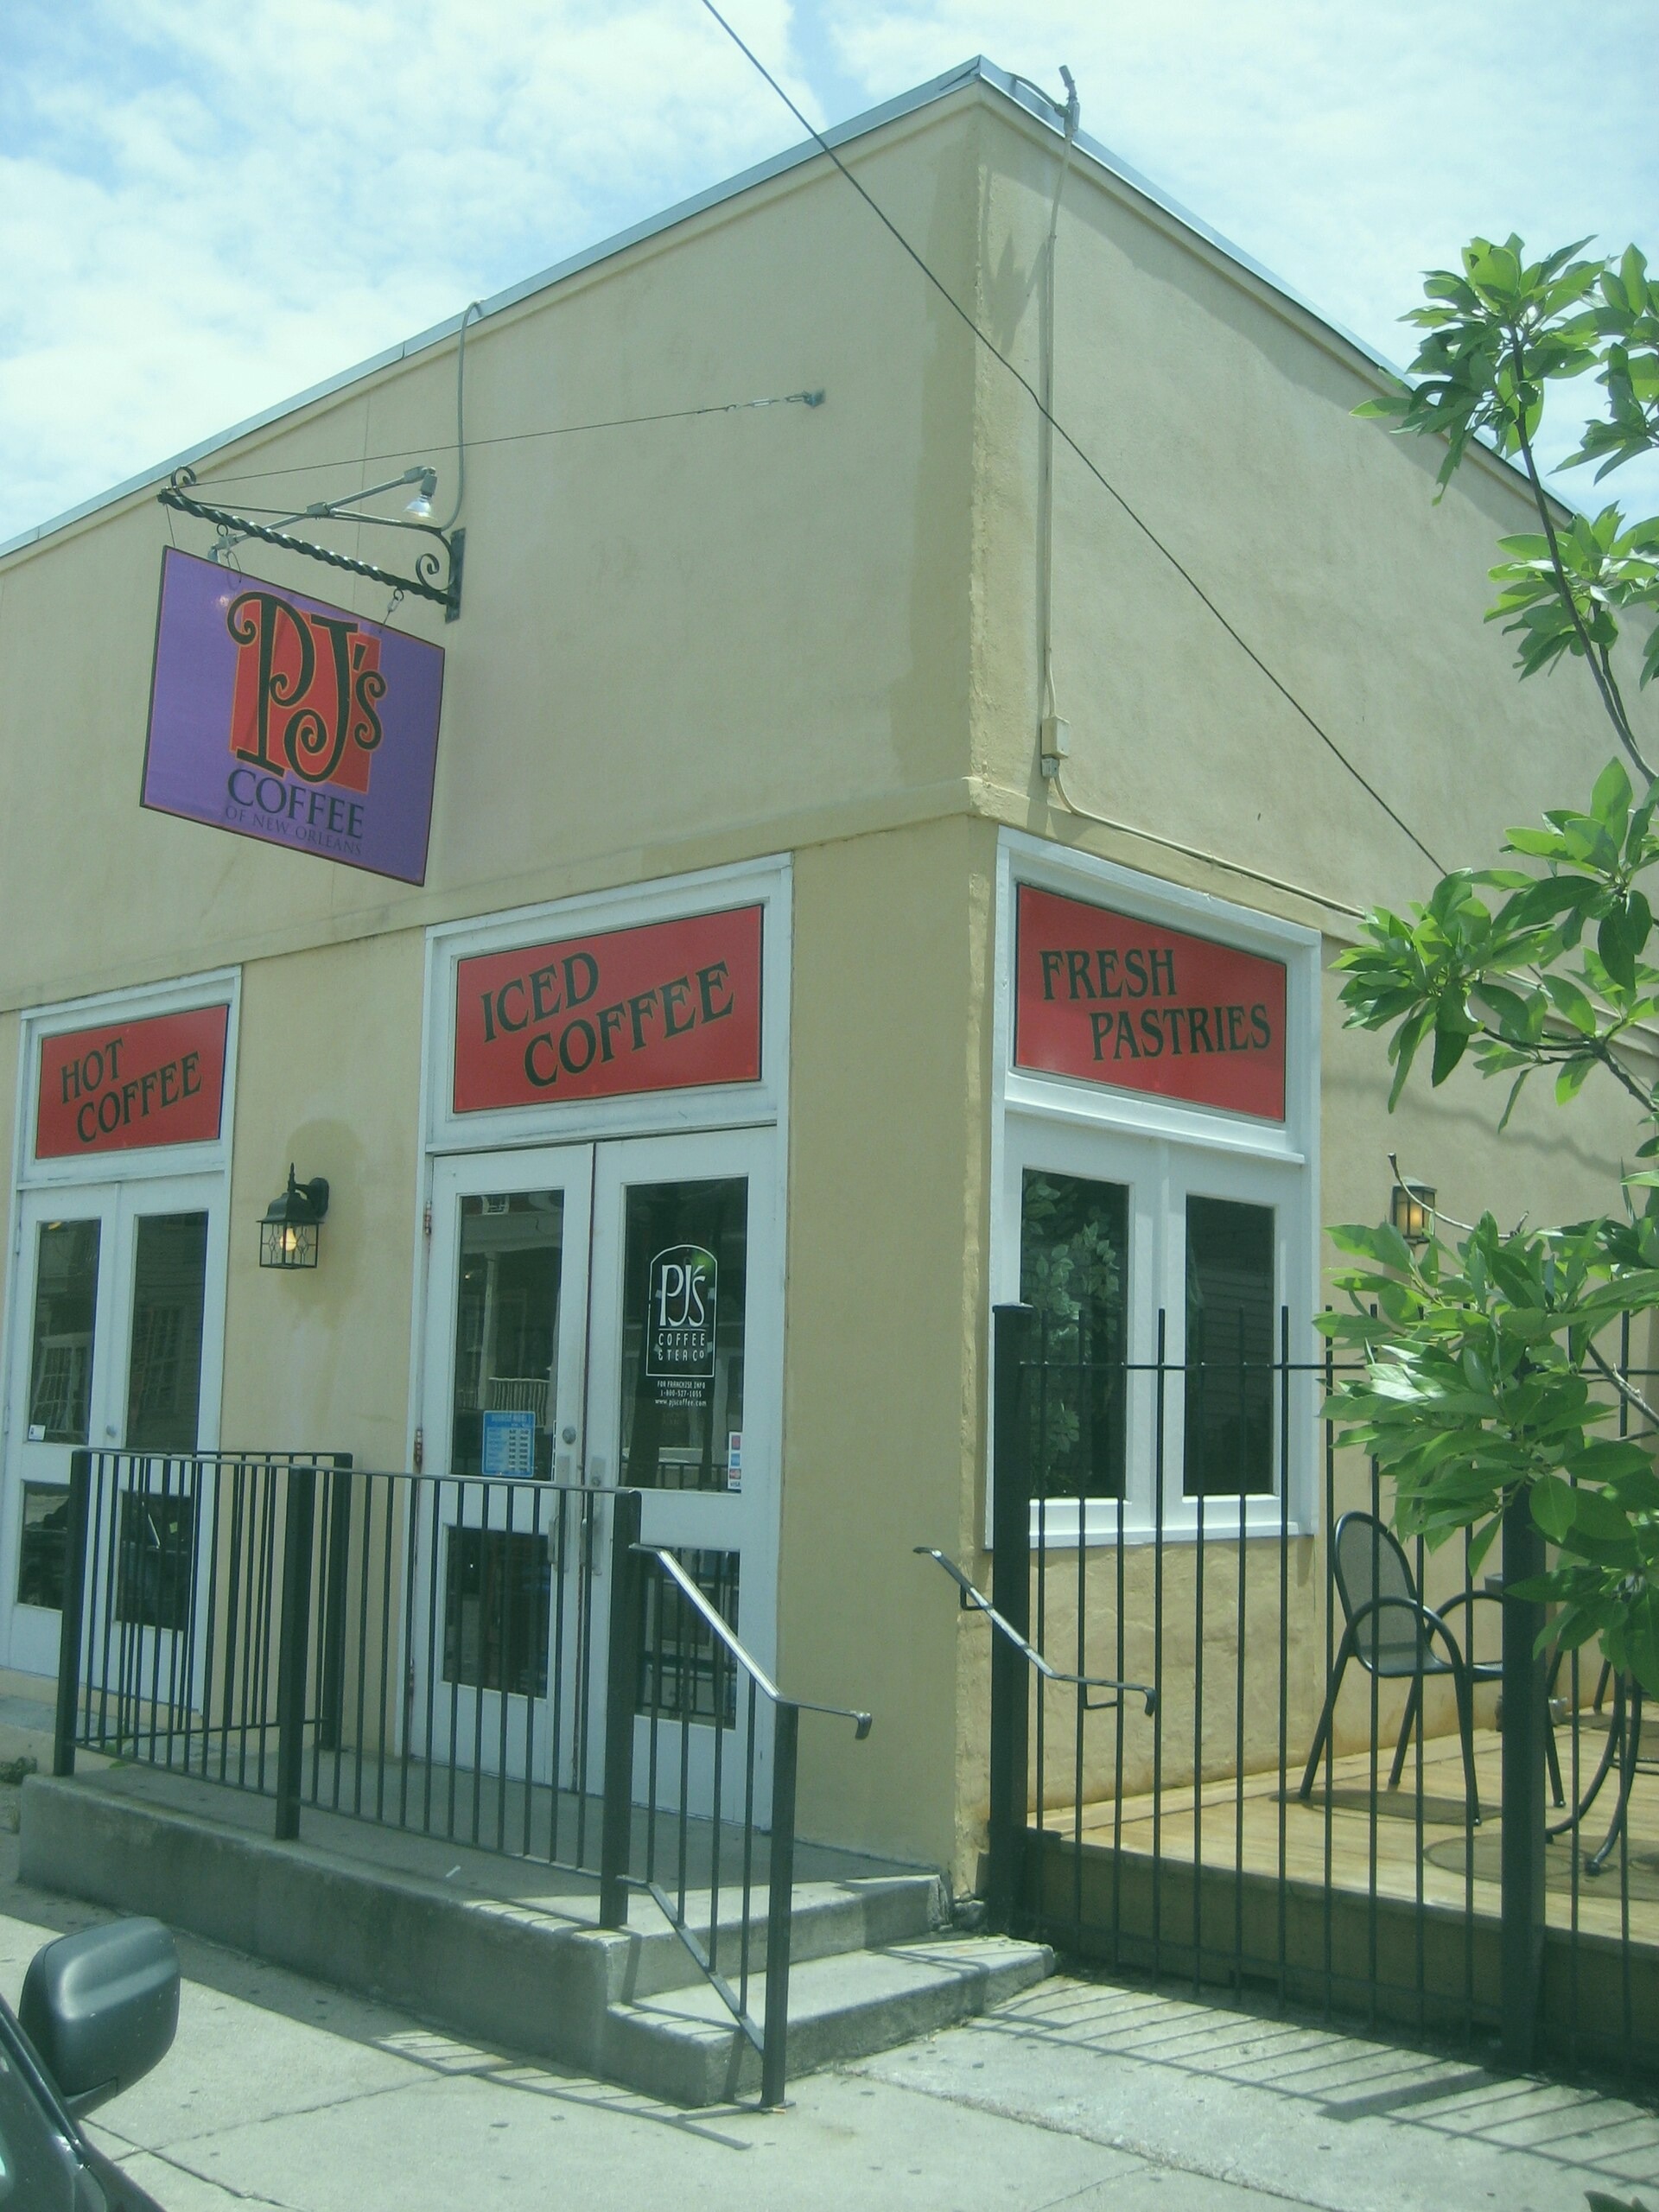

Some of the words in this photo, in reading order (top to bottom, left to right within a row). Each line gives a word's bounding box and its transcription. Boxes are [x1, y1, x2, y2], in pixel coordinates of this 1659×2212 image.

[225, 804, 246, 823] OF
[251, 813, 290, 836] NEW
[296, 825, 361, 856] ORLEANS
[227, 768, 365, 840] COFFEE
[480, 951, 599, 1043] ICED
[1039, 949, 1177, 1001] FRESH
[524, 961, 734, 1087] COFFEE
[1090, 1004, 1271, 1061] PASTRIES
[60, 1038, 124, 1104] HOT
[77, 1051, 202, 1143] COFFEE
[658, 1333, 705, 1346] COFFEE
[667, 1350, 688, 1362] TEA
